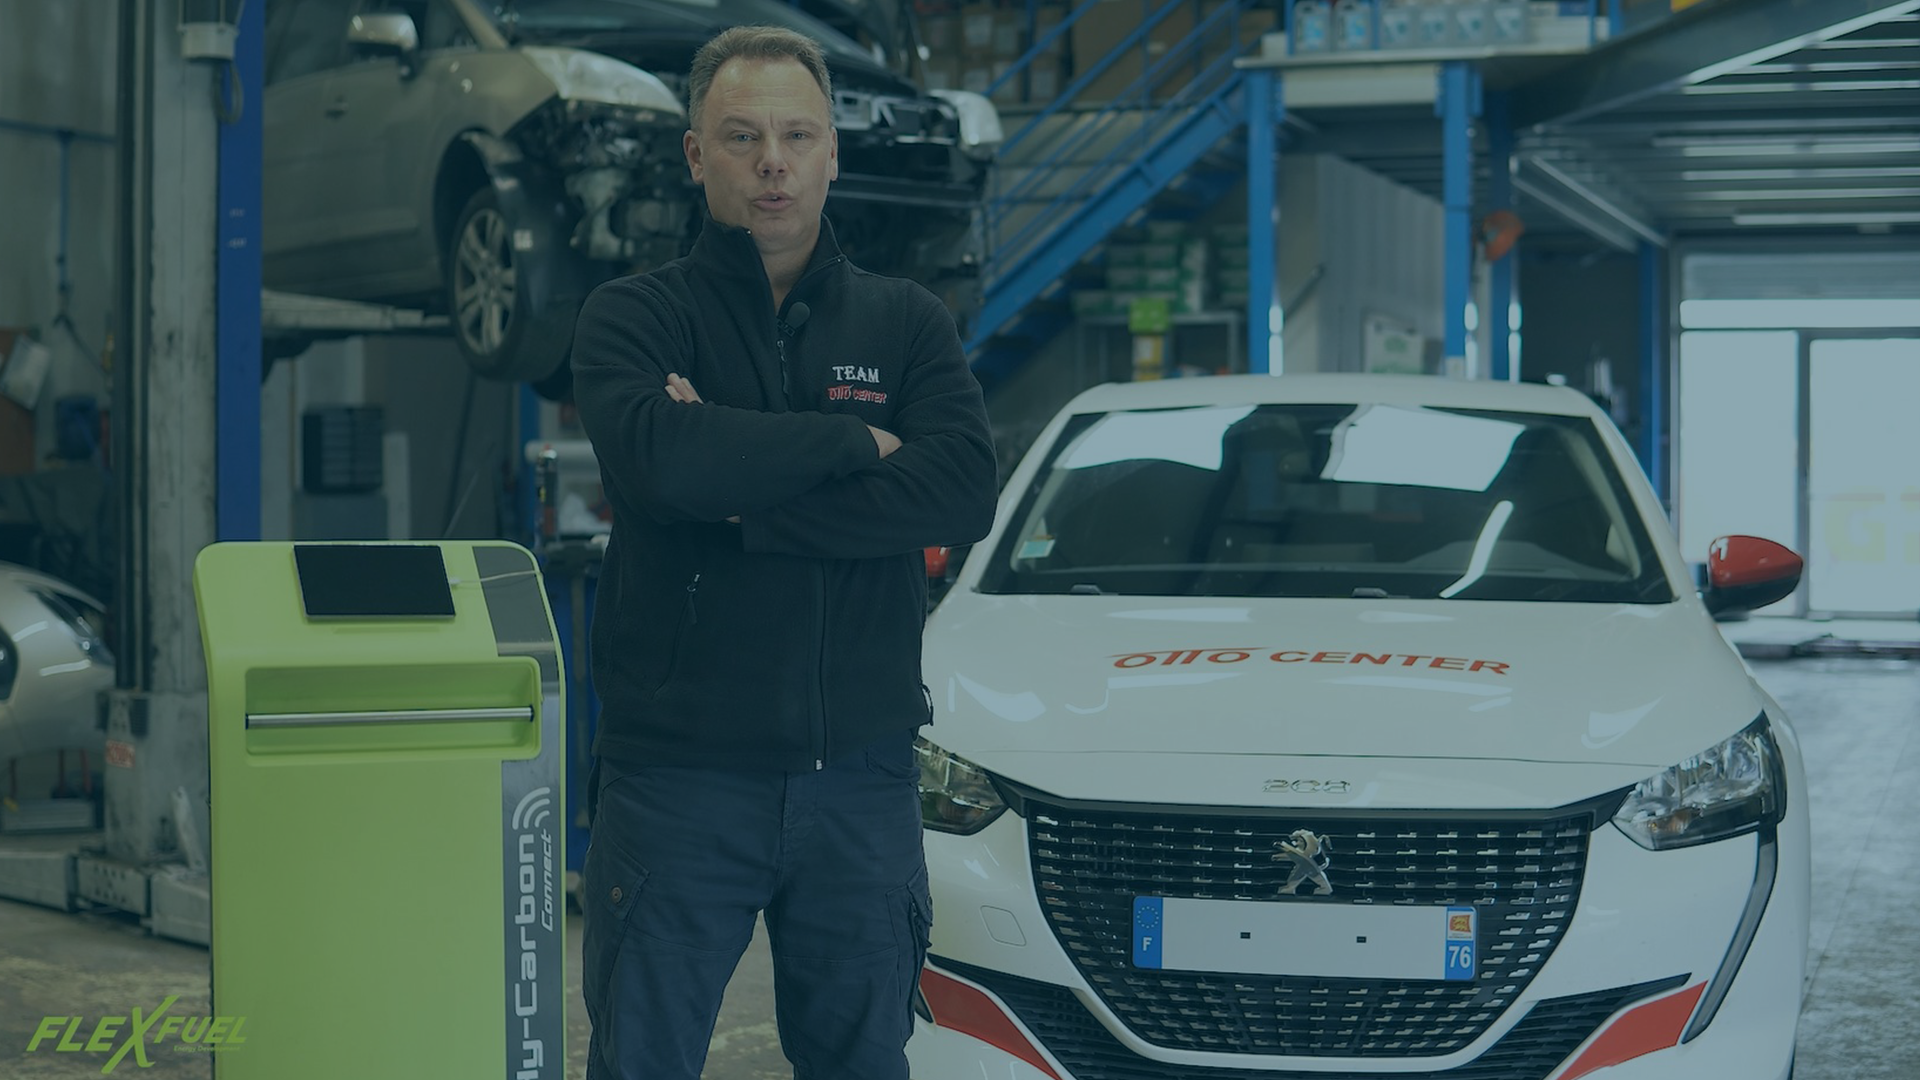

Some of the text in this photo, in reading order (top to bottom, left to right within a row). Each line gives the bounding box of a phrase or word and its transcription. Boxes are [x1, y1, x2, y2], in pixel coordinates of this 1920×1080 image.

[832, 365, 880, 383] TEAM
[853, 389, 887, 404] CENTER
[1105, 647, 1510, 675] OTTO CENTER
[540, 828, 554, 931] Connect
[1142, 936, 1153, 952] F
[1448, 945, 1472, 969] 76
